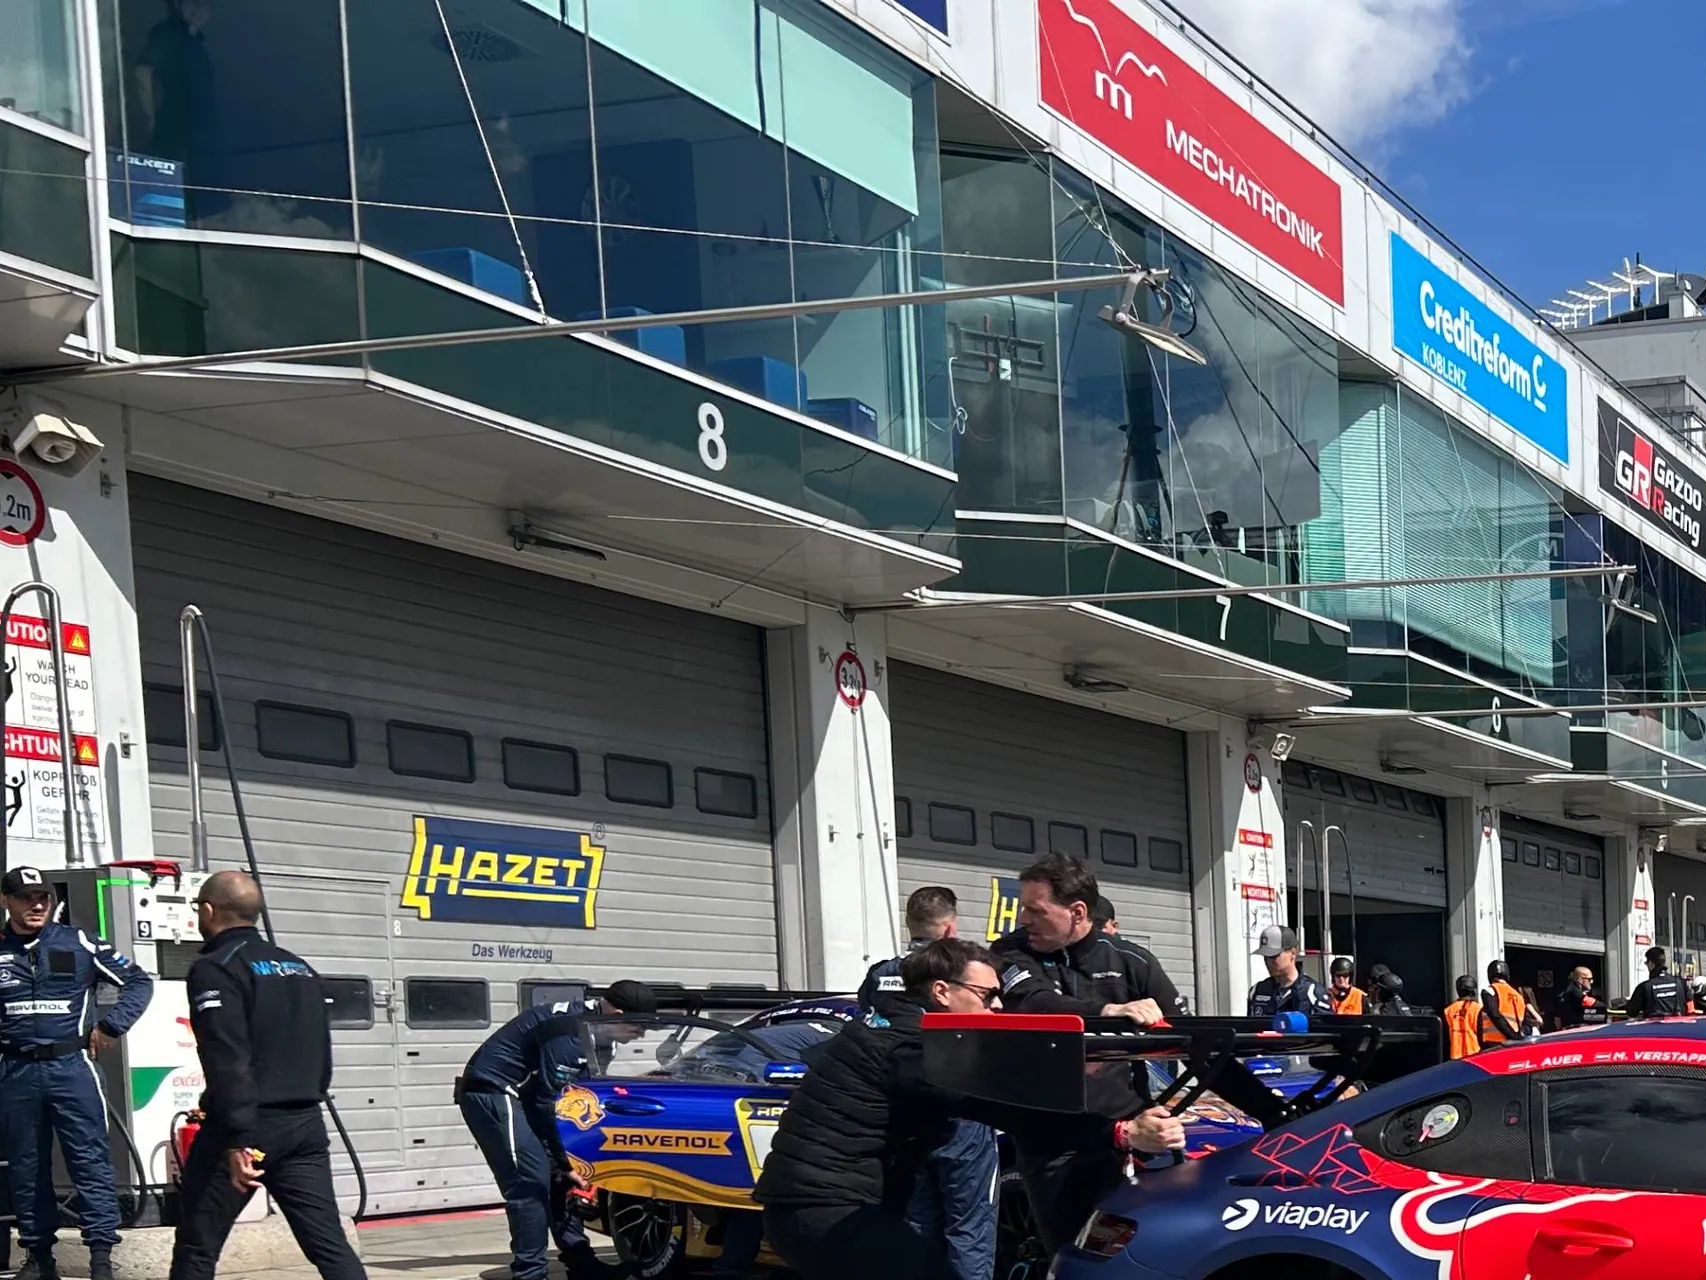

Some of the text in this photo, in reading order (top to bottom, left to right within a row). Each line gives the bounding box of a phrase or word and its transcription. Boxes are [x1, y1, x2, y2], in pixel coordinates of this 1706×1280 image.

[1166, 119, 1325, 259] MECHATRONIK
[1420, 280, 1532, 402] Creditreform
[1422, 341, 1467, 392] KOBLENZ
[698, 403, 728, 471] 8
[1617, 450, 1650, 506] GR
[1654, 456, 1702, 512] GAZOO
[1653, 486, 1700, 547] Racing
[1216, 595, 1231, 641] 7
[64, 678, 89, 691] EAD
[1491, 697, 1502, 733] 6
[425, 844, 586, 896] HAZET
[140, 922, 150, 937] 9
[393, 919, 401, 936] 8
[472, 943, 553, 962] Das Werkzeug
[1524, 1053, 1583, 1069] L. AUER
[1612, 1051, 1629, 1061] M.
[612, 1133, 721, 1149] RAVENOL
[1265, 1201, 1370, 1235] viaplay
